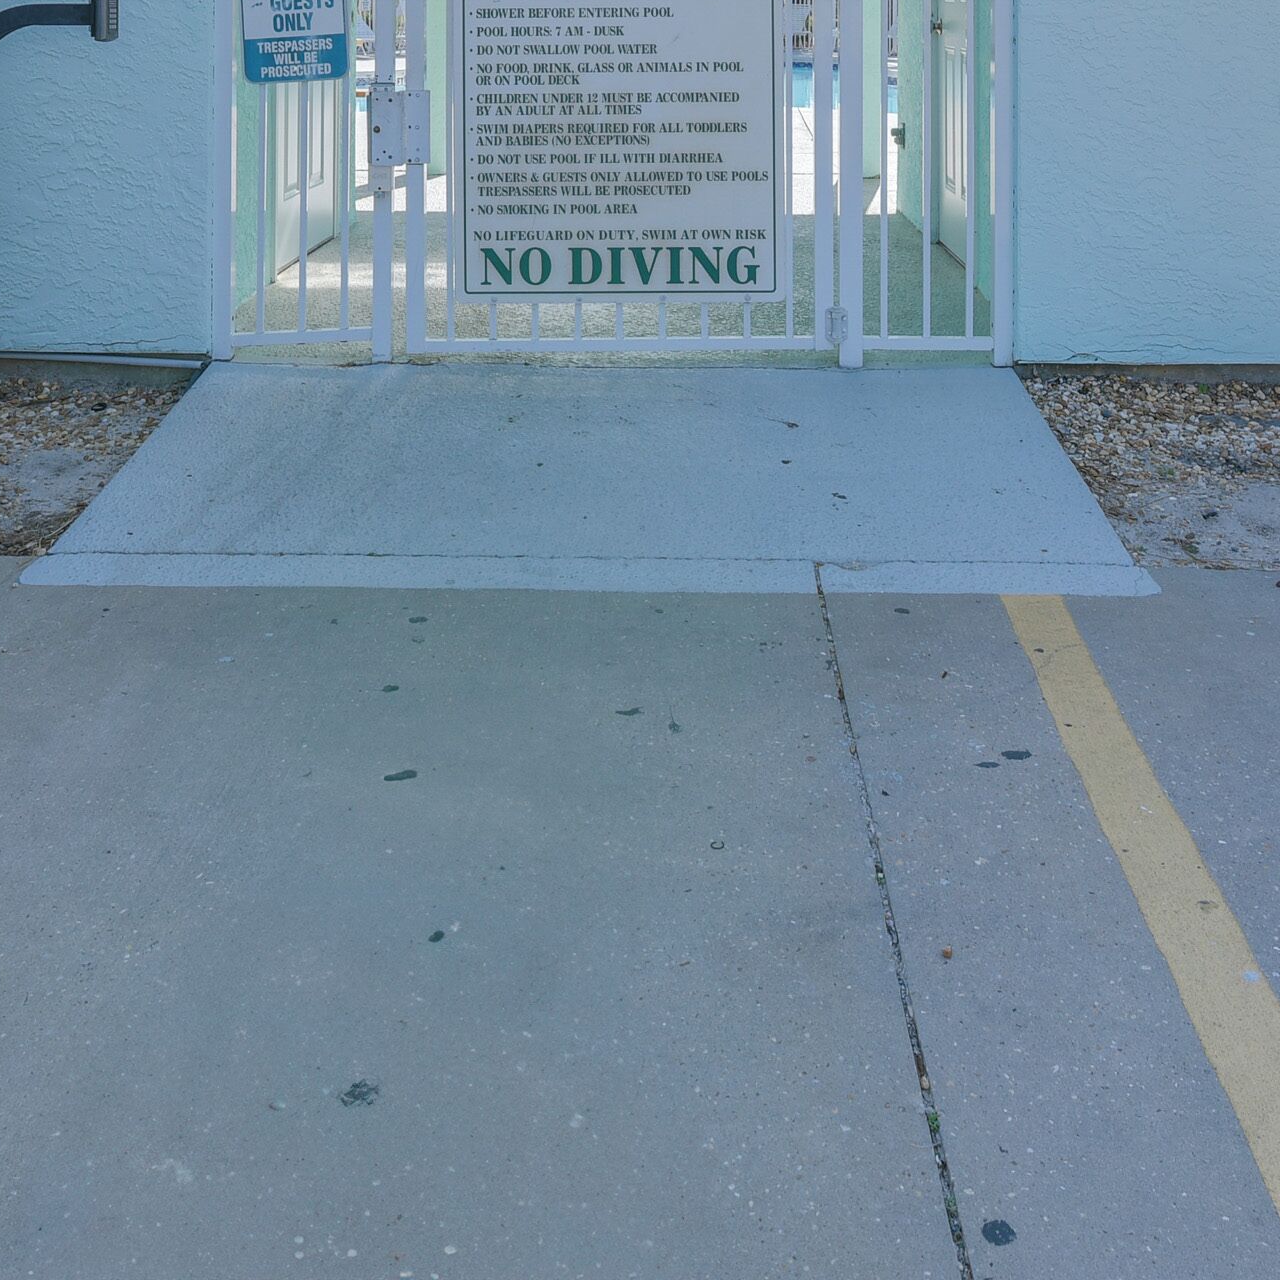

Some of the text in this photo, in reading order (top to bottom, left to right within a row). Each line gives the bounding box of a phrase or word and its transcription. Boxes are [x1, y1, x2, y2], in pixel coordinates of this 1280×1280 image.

[476, 7, 674, 19] SHOWER BEFORE ENTERING POOL
[273, 12, 314, 33] ONLY
[476, 26, 508, 38] POOL
[511, 26, 552, 37] HOURS:
[555, 26, 562, 37] 7
[565, 26, 584, 37] AM
[594, 26, 624, 36] DUSK
[257, 38, 334, 55] TRESPASSERS
[477, 44, 658, 56] DO NOT SWALLOW POOL WATER
[273, 51, 318, 65] WILL BE
[260, 63, 332, 79] PROSECUTED
[476, 62, 744, 75] NO FOOD, DRINK, GLASS OR ANIMALS IN POOL
[476, 74, 580, 86] OR ON POOL DECK
[476, 92, 740, 104] CHILDREN UNDER 12 MUST BE ACCOMPANIED
[476, 104, 642, 116] BY AN ADULT AT ALL TIMES
[476, 122, 748, 135] SWIM DIAPERS REQUIRED FOR ALL TODDLERS
[476, 134, 650, 146] AND BABIES (NO EXCEPTIONS)
[477, 152, 723, 165] DO NOT USE POOL IF ILL WITH DIARRHEA
[477, 171, 769, 183] OWNERS & GUESTS ONLY ALLOWED TO USE POOLS
[477, 185, 691, 197] TRESPASSERS WILL BE PROSECUTED
[478, 203, 638, 215] NO SMOKING IN POOL AREA
[473, 229, 766, 241] NO LIFEGUARD ON DUTY, SWIM AT OWN RISK
[480, 246, 761, 286] NO DIVING
